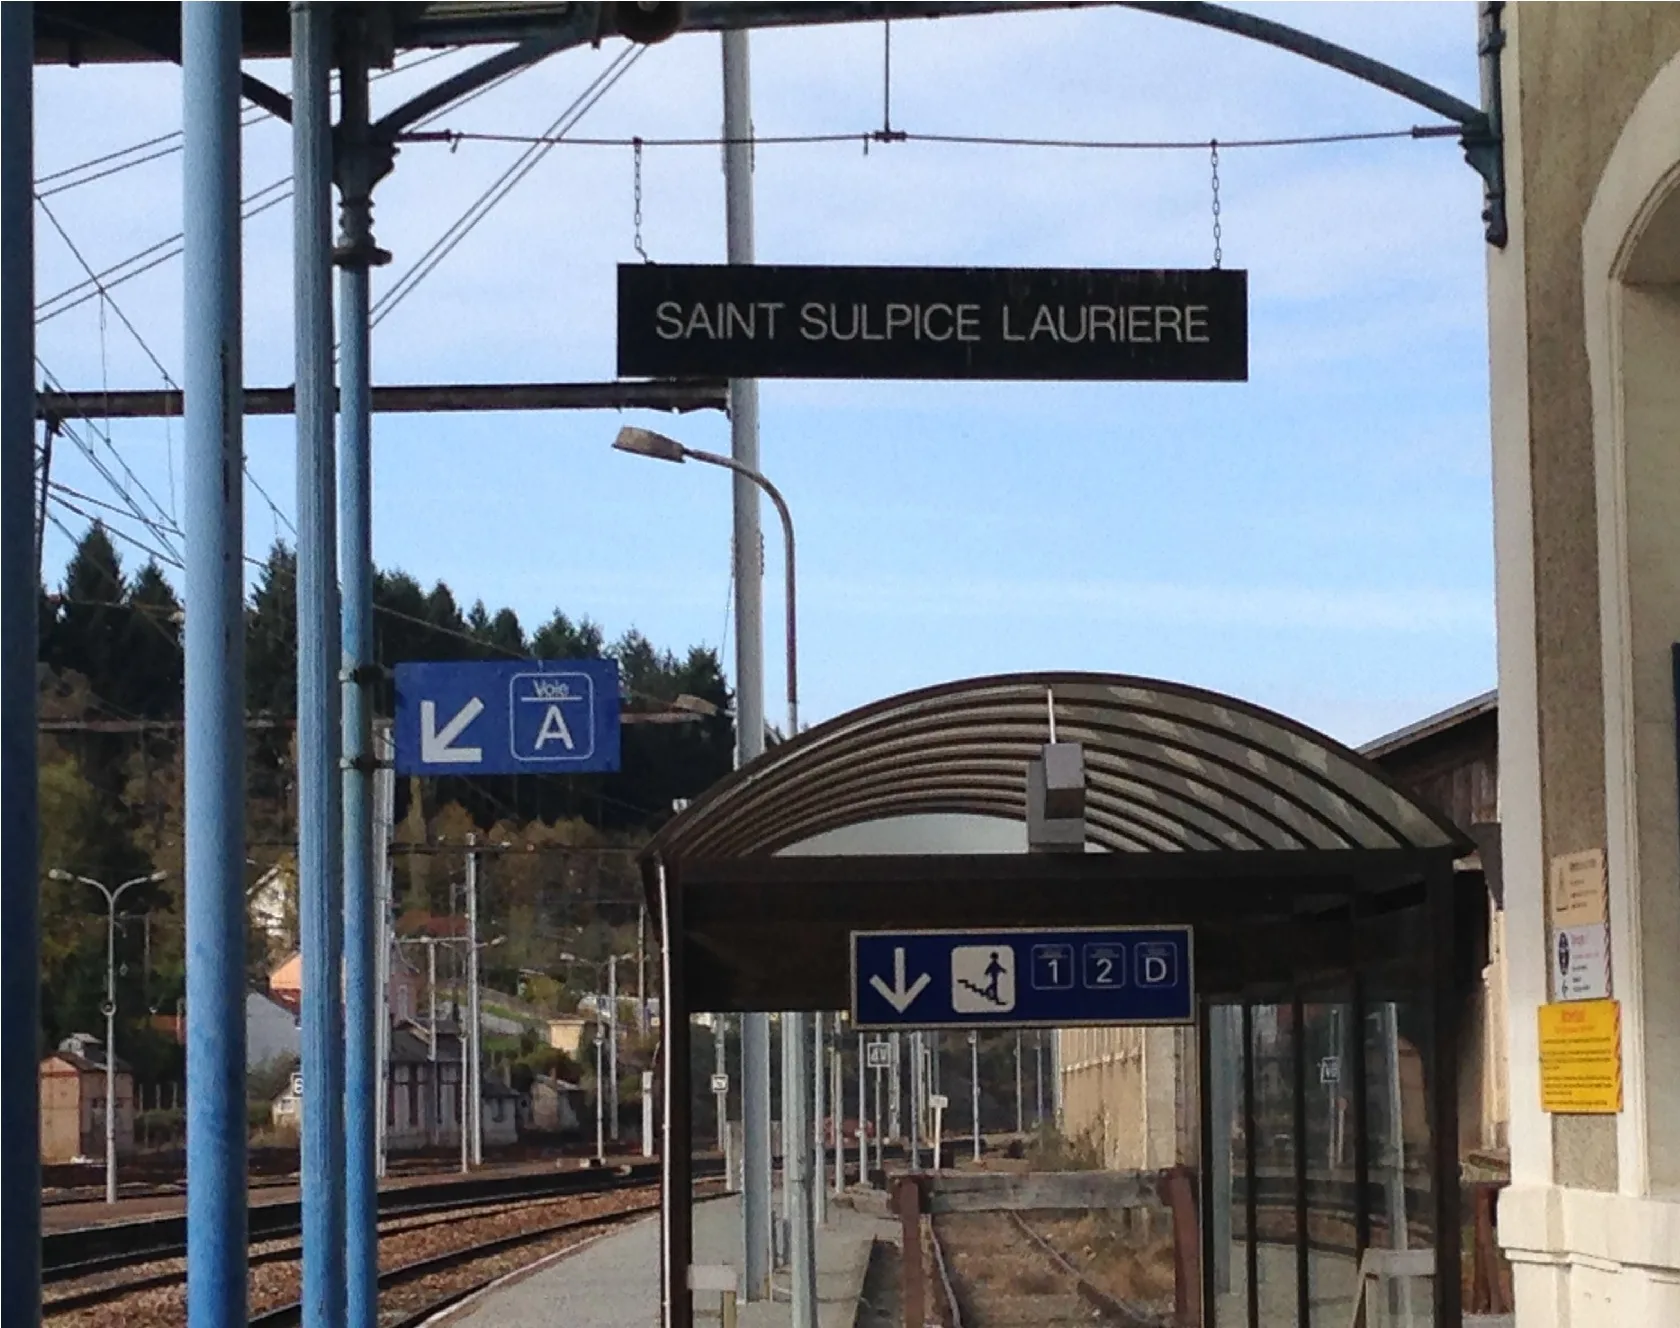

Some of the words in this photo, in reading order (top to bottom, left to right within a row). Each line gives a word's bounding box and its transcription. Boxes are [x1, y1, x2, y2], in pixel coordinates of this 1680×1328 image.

[655, 301, 786, 340] SAINT
[800, 302, 981, 341] SULPICE
[1002, 303, 1210, 343] LAURIERE
[534, 704, 574, 750] A
[1048, 958, 1059, 984] 1
[1096, 958, 1113, 983] 2
[1145, 956, 1168, 983] D
